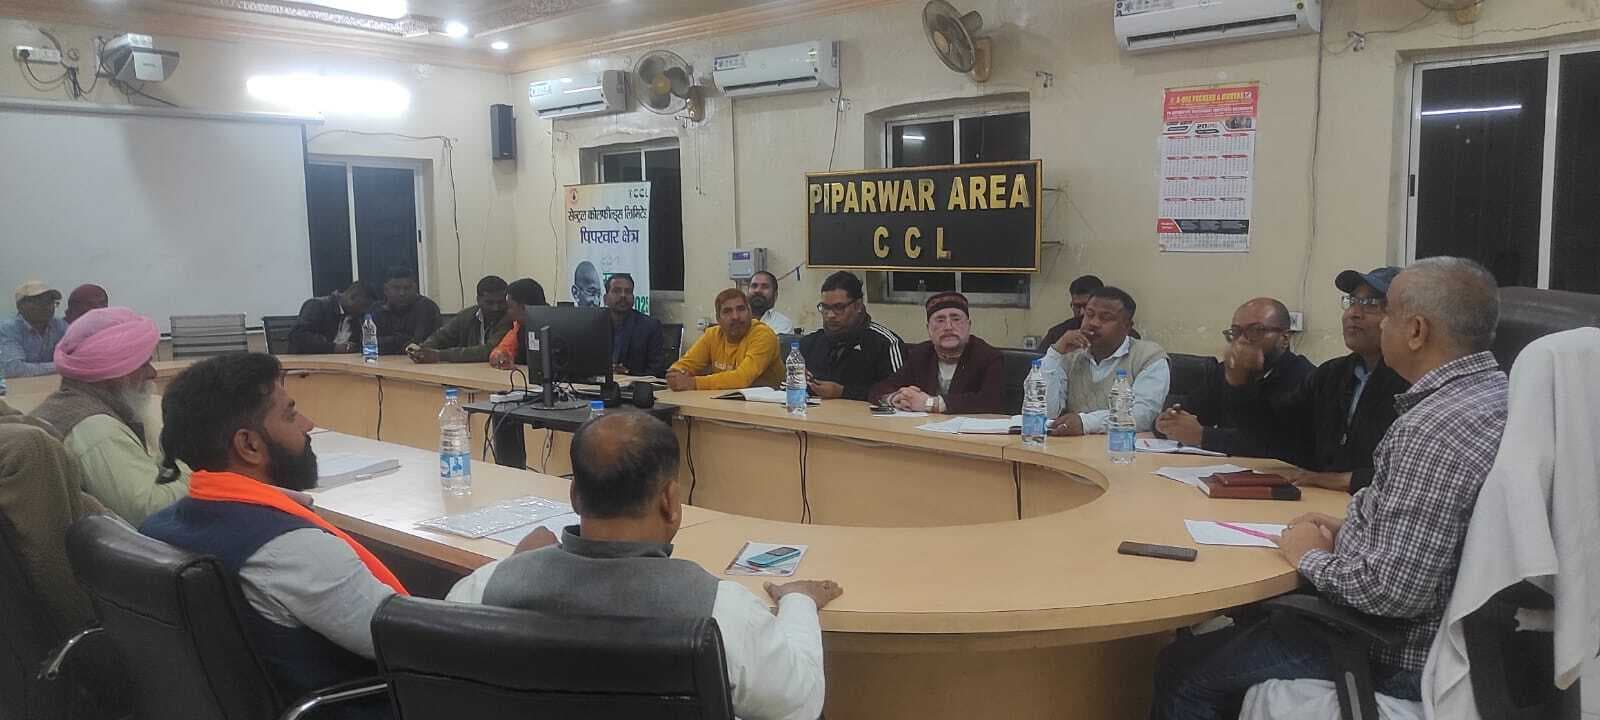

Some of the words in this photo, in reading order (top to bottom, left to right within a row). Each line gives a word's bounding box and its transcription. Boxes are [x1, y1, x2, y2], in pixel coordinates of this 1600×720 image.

[809, 178, 936, 214] PIPARWAR
[947, 173, 1033, 210] AREA
[580, 226, 620, 244] पिपरवार
[622, 226, 639, 244] क्षेत्र
